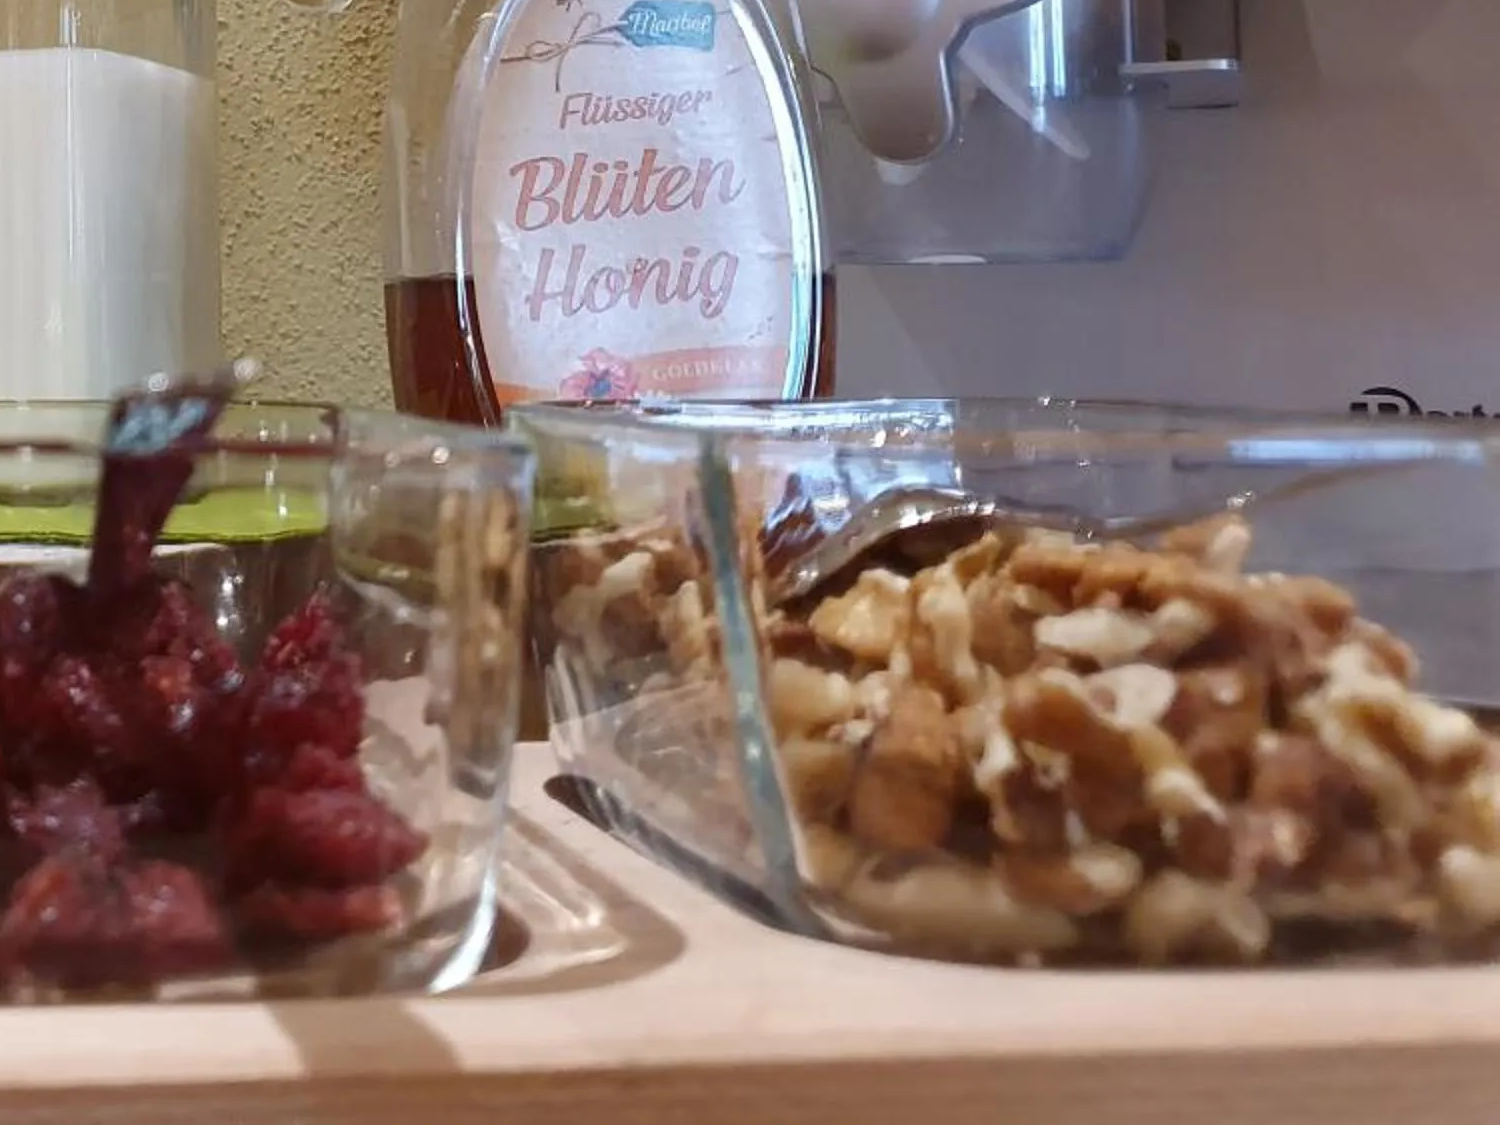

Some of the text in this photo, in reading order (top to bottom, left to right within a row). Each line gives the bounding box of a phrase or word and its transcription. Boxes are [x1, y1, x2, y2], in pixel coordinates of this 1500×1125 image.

[560, 90, 713, 130] Flüssiger
[509, 148, 746, 231] Blüten
[525, 244, 739, 322] Honig
